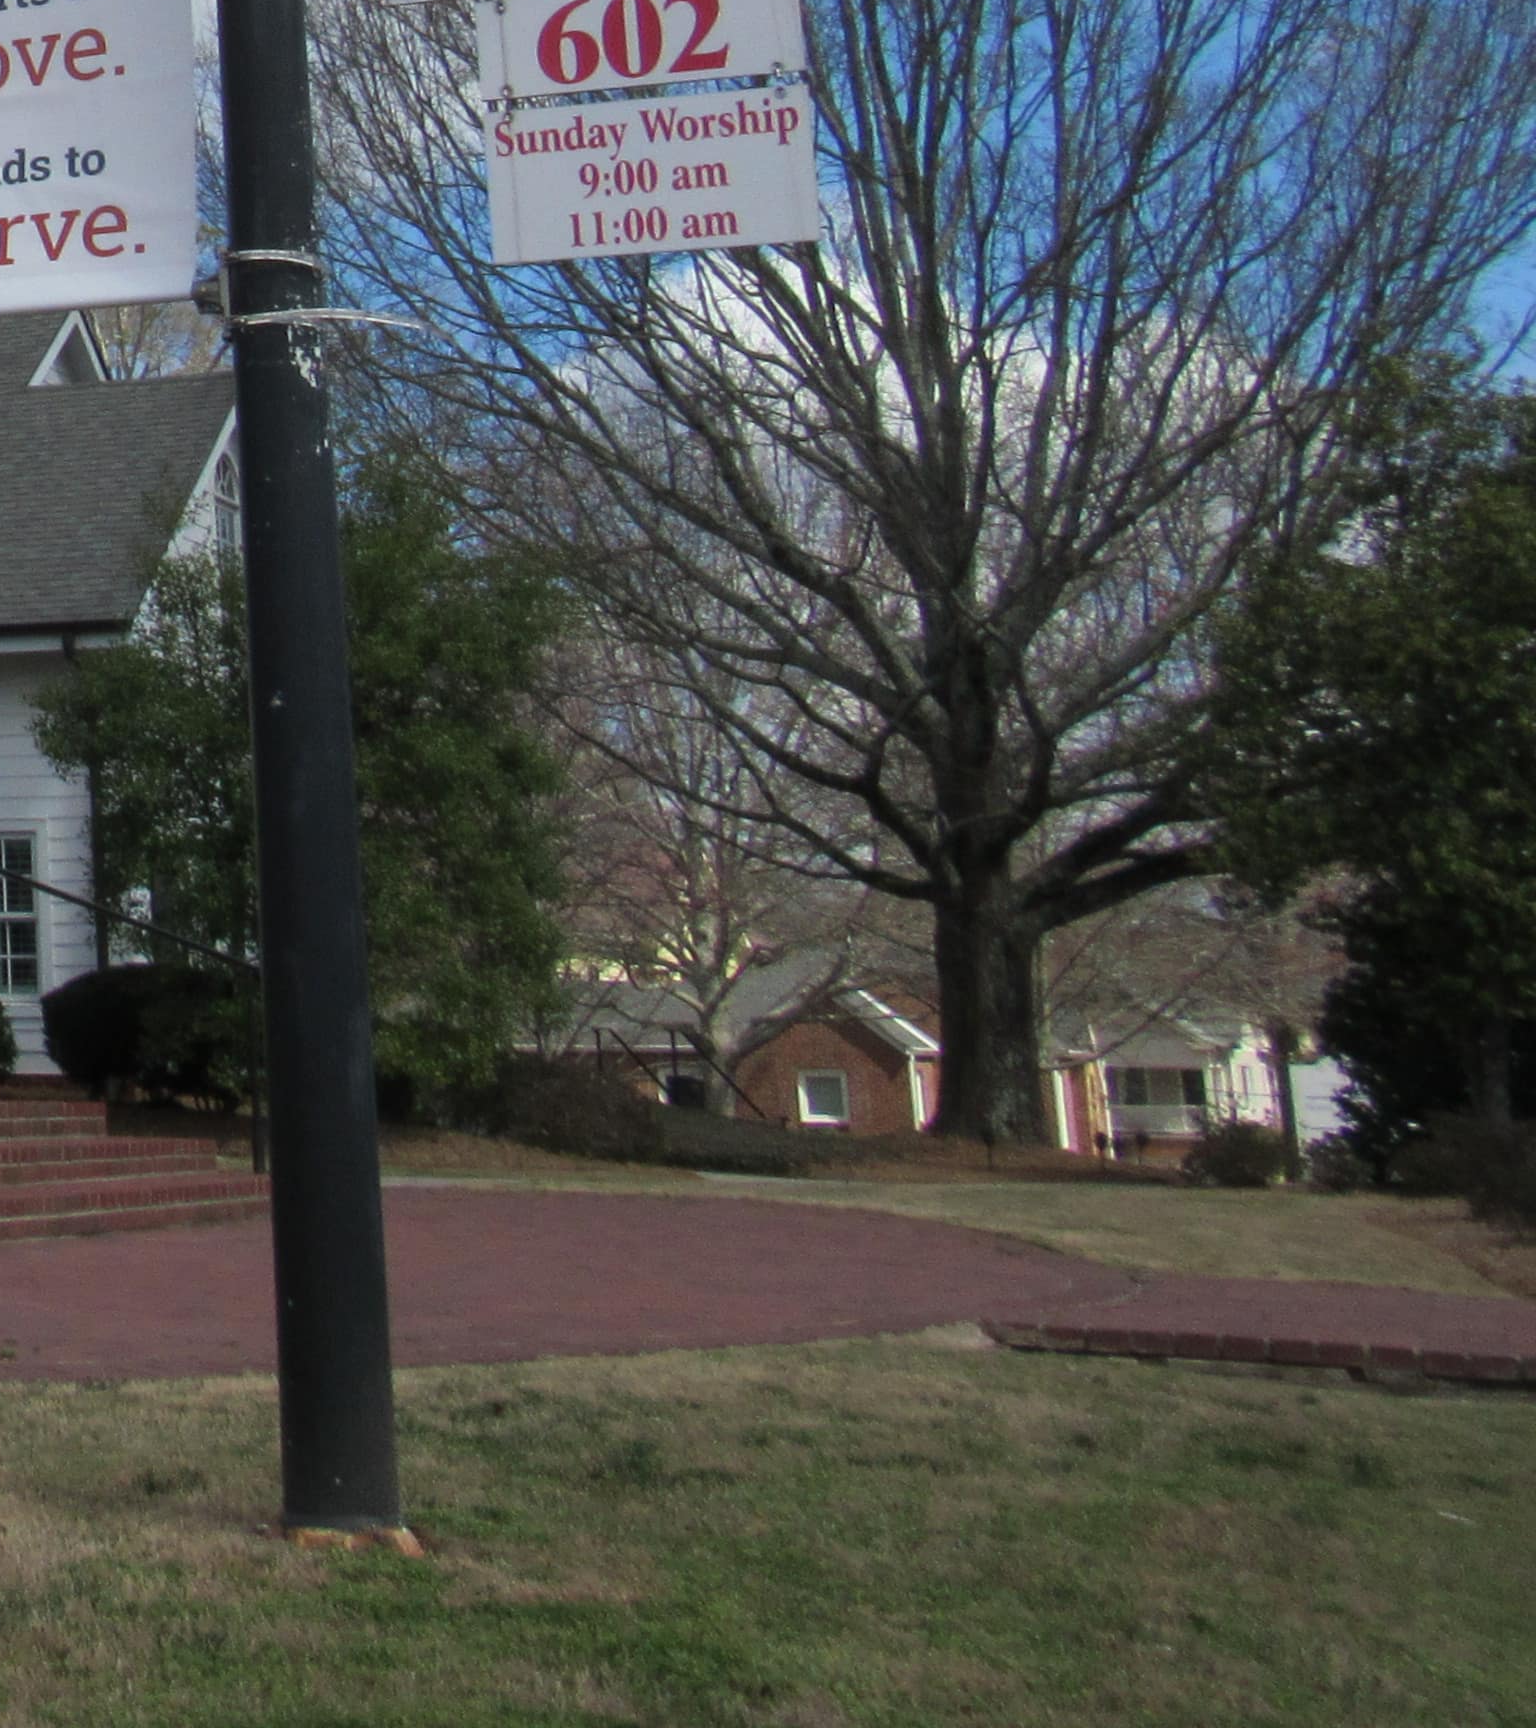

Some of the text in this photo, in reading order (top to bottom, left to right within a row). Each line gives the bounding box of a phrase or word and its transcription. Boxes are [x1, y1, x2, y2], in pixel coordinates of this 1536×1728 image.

[494, 98, 799, 160] Sunday Worship
[64, 147, 106, 179] to
[579, 158, 730, 199] 9:00 am
[570, 206, 740, 247] 11:00 am
